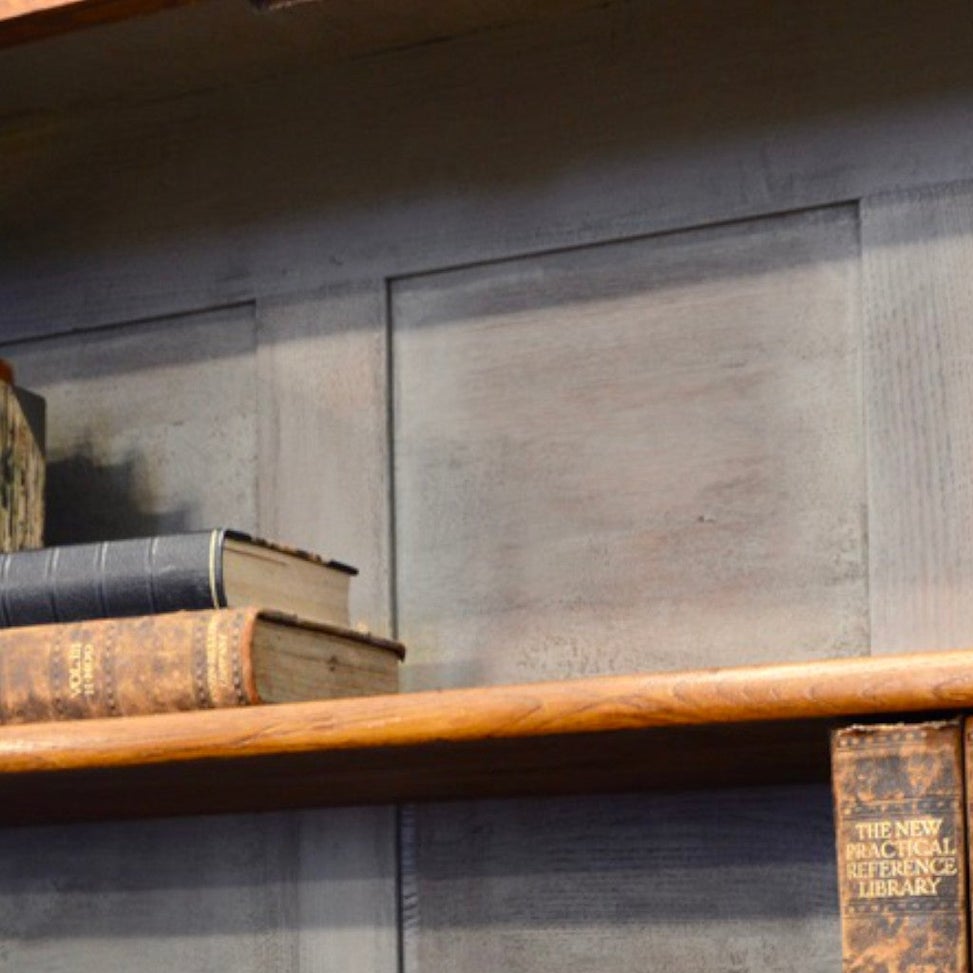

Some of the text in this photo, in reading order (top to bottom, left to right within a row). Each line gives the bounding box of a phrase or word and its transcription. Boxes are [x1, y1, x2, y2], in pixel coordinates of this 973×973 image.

[855, 818, 943, 839] THE NEW
[846, 837, 957, 860] PRACTICAL
[846, 857, 958, 881] REFERENCE
[859, 877, 942, 898] LIBRARY
